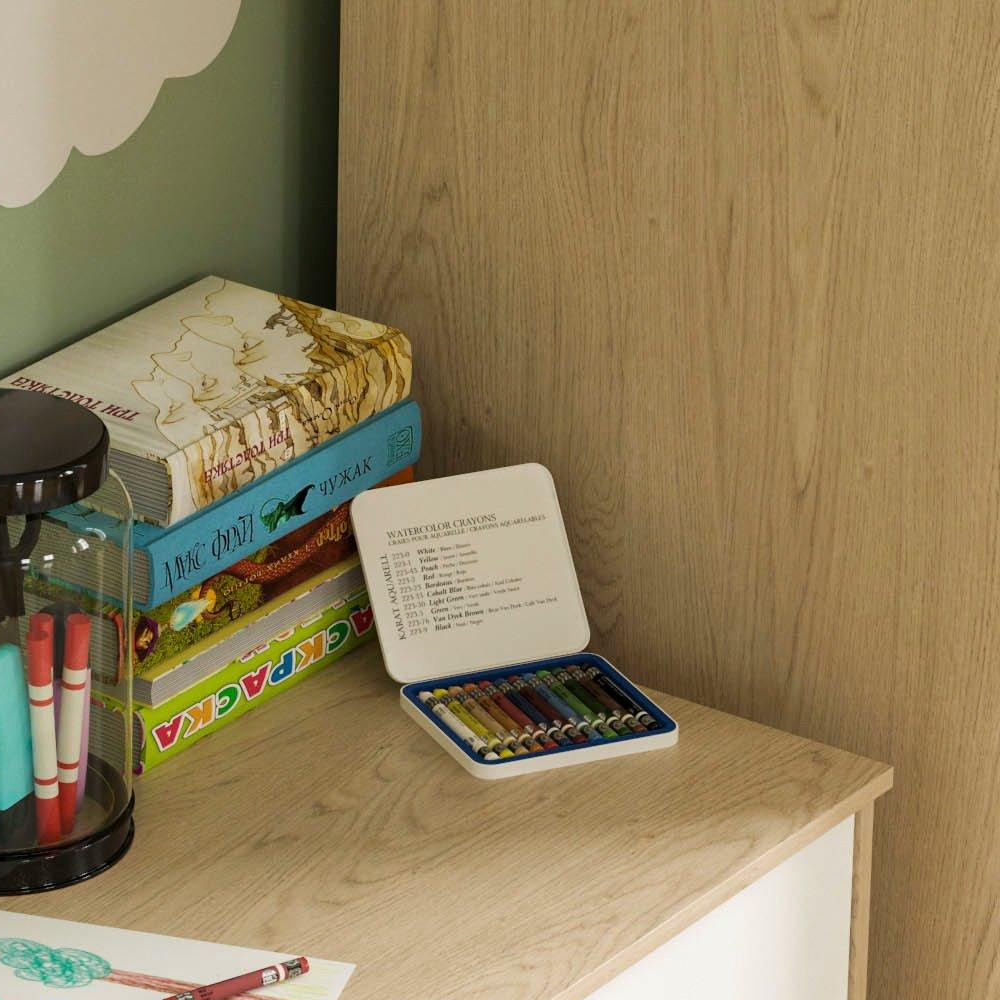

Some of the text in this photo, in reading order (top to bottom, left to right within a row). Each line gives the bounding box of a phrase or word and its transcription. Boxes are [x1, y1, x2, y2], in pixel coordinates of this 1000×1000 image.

[319, 456, 374, 496] ЧУЖАК
[386, 513, 497, 540] WATERCOLOR CRAYONS
[379, 553, 407, 641] KARAT AQUARELL
[435, 622, 452, 632] Black
[152, 602, 375, 752] АСКРАСКА
